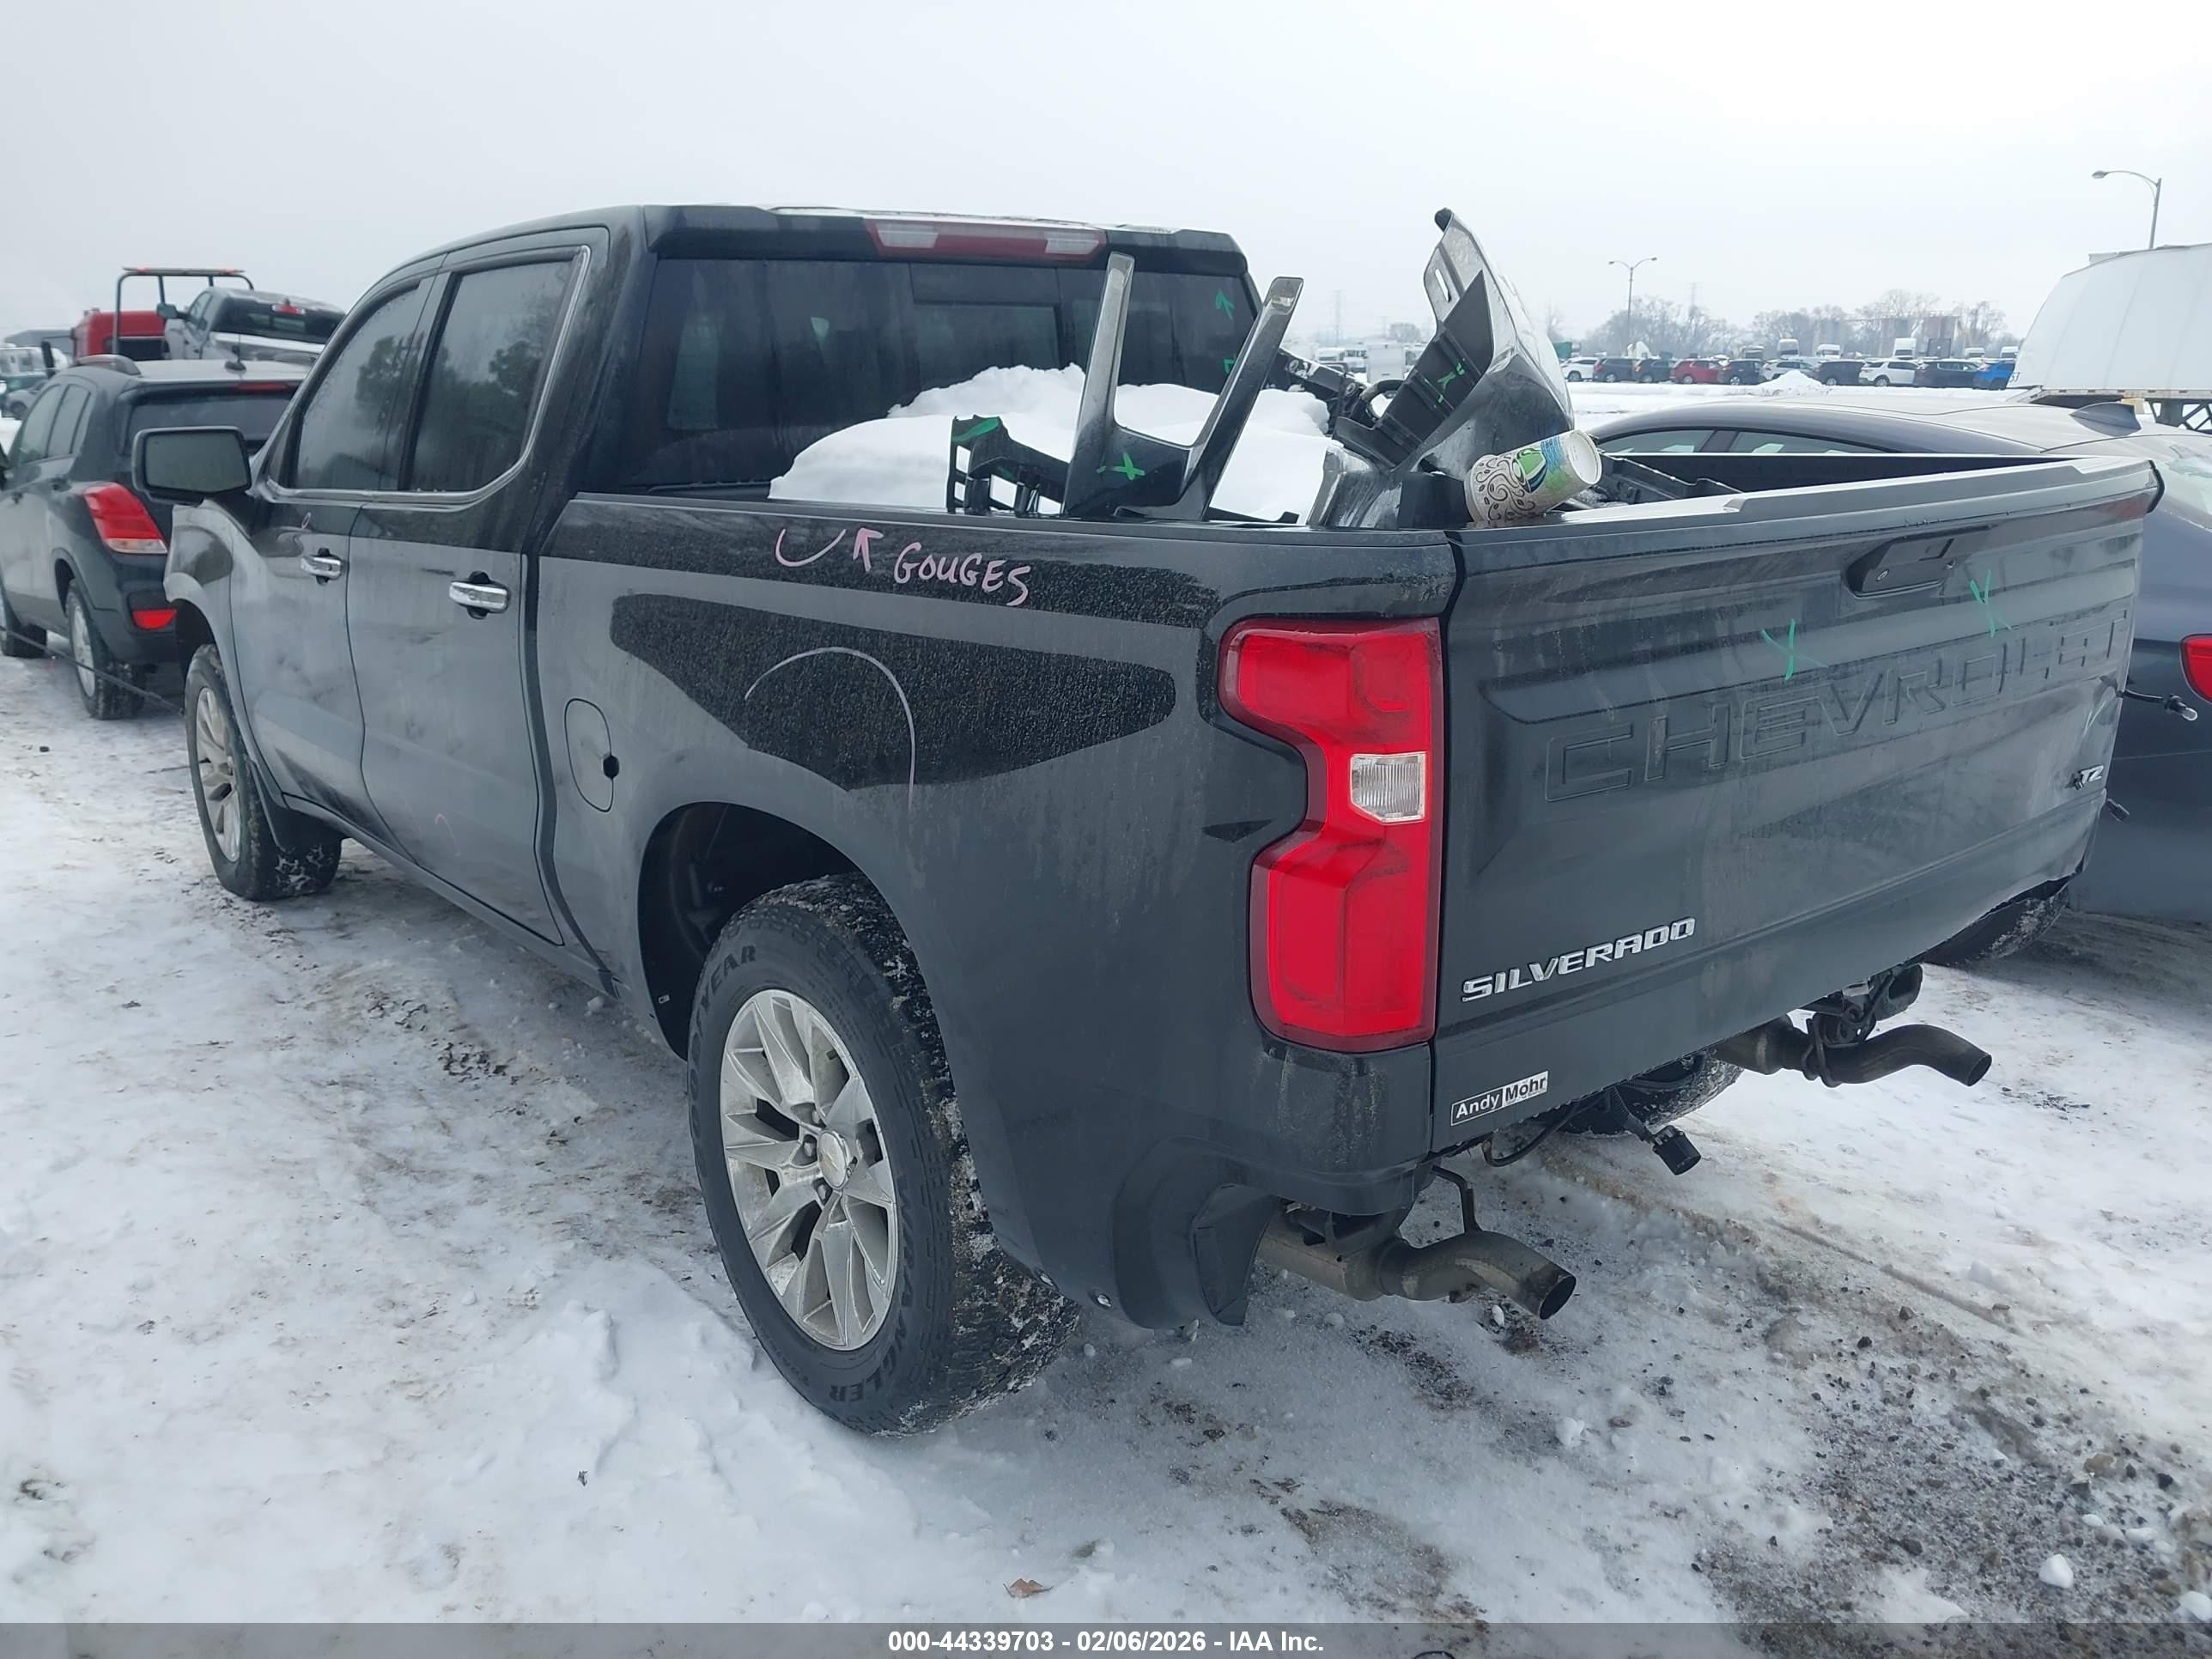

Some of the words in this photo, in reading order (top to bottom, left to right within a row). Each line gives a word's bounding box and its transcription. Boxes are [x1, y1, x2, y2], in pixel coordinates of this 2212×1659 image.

[893, 542, 1030, 606] GOUGES
[1545, 609, 2128, 802] CHEVROLET
[1462, 916, 1696, 1002] SILVERADO
[1456, 1093, 1500, 1118] Andy
[1505, 1078, 1547, 1102] Mohr
